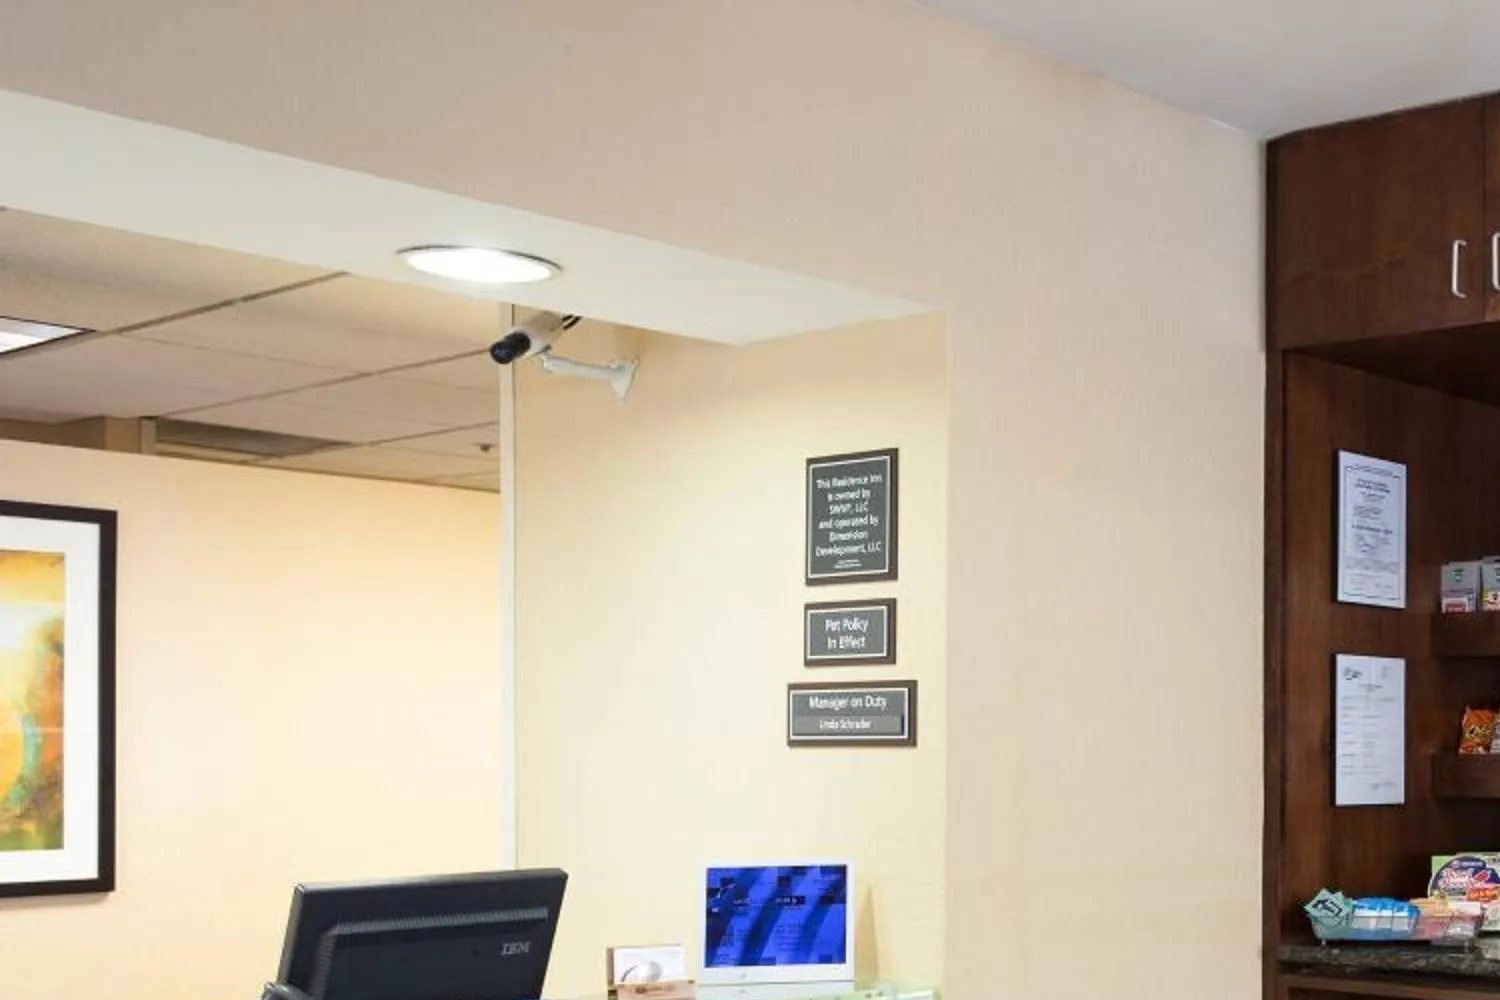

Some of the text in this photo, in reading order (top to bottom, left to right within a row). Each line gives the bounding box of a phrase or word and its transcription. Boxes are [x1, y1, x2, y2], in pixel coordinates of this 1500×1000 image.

[834, 516, 868, 529] operated
[825, 617, 869, 632] Pet Policy
[827, 635, 866, 648] In Effect
[809, 695, 886, 711] Manager on Duty
[501, 941, 532, 956] IBM
